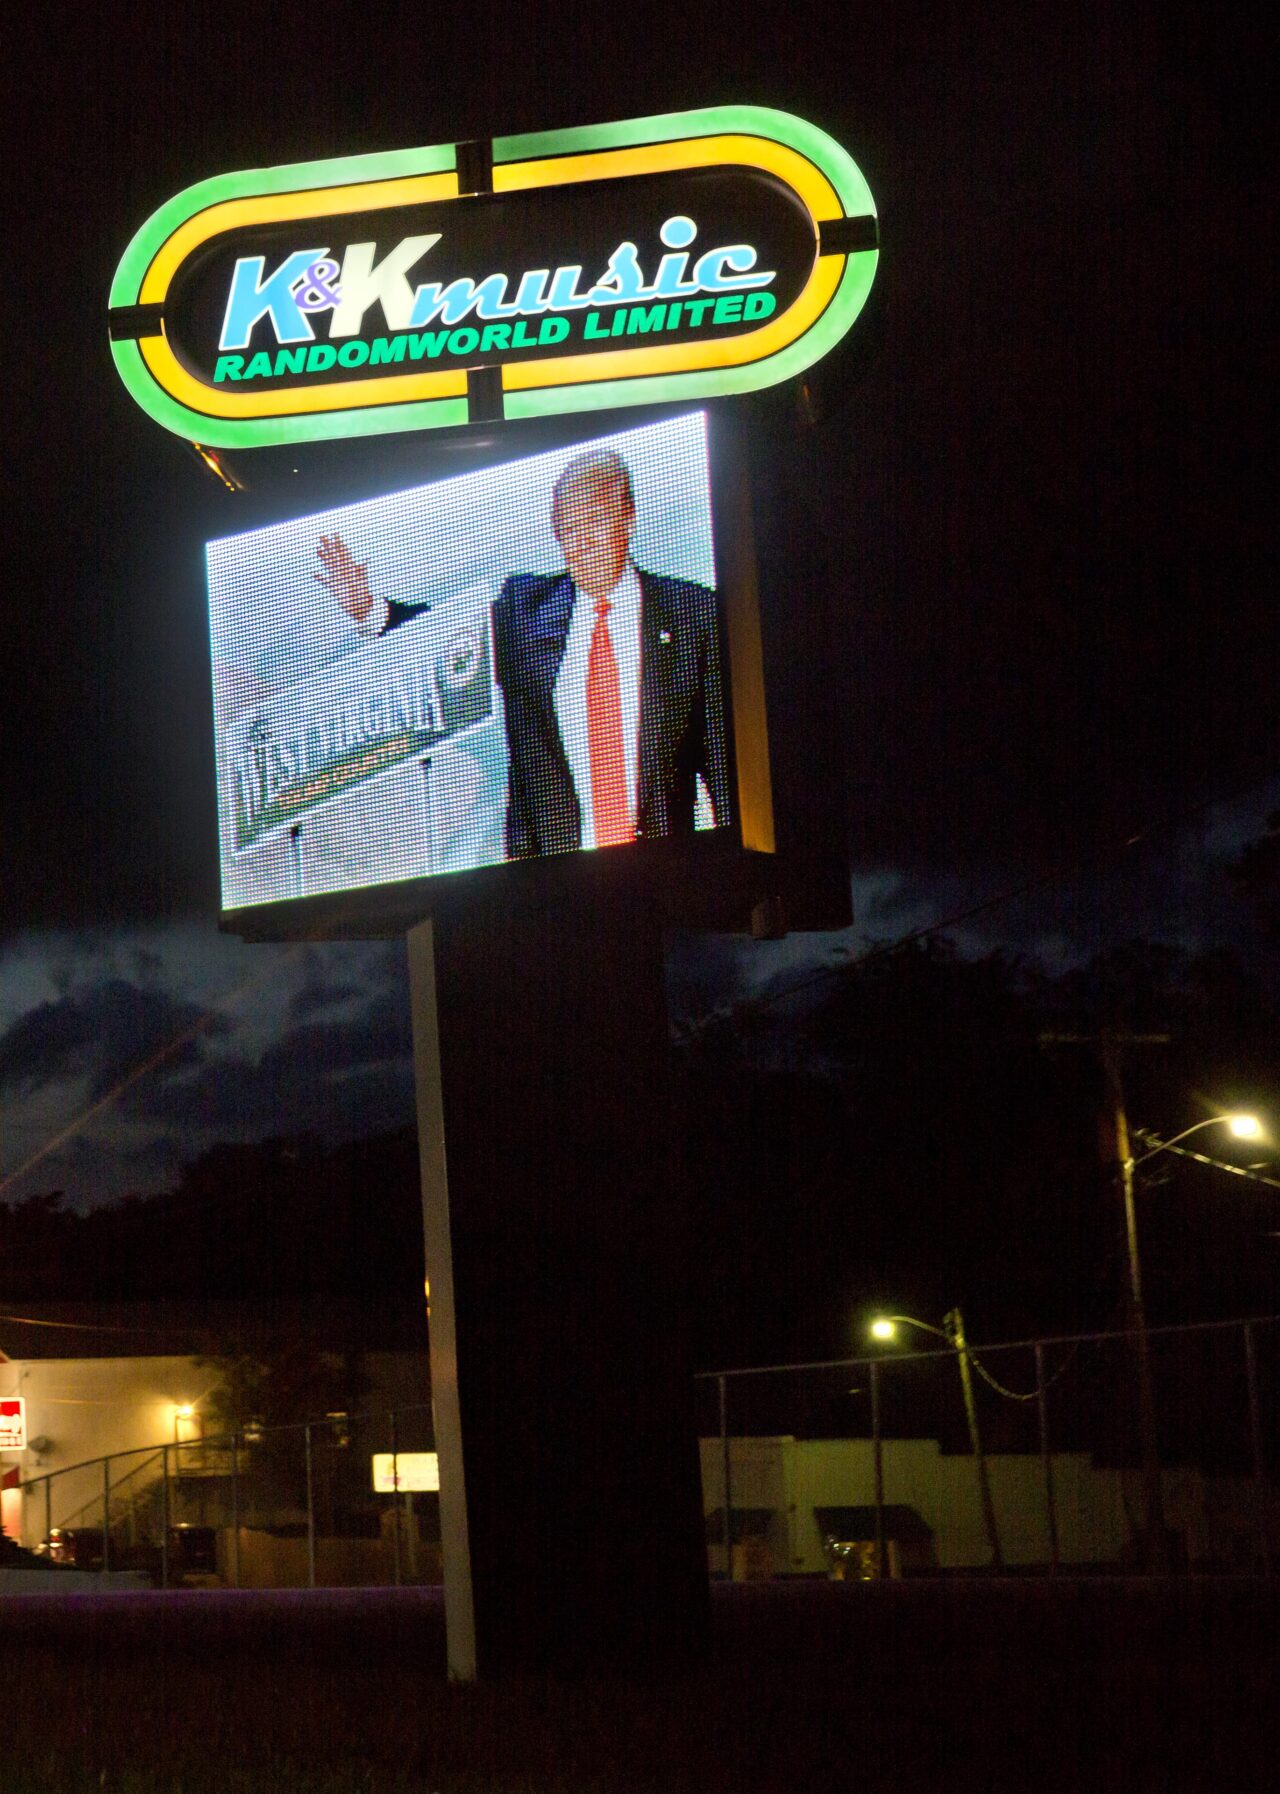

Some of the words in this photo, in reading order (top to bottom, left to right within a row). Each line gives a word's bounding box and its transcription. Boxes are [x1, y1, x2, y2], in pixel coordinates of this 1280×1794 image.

[213, 315, 570, 382] RANDOMWORLD
[583, 292, 777, 340] LIMITED
[218, 233, 442, 351] K&K
[408, 215, 777, 327] music
